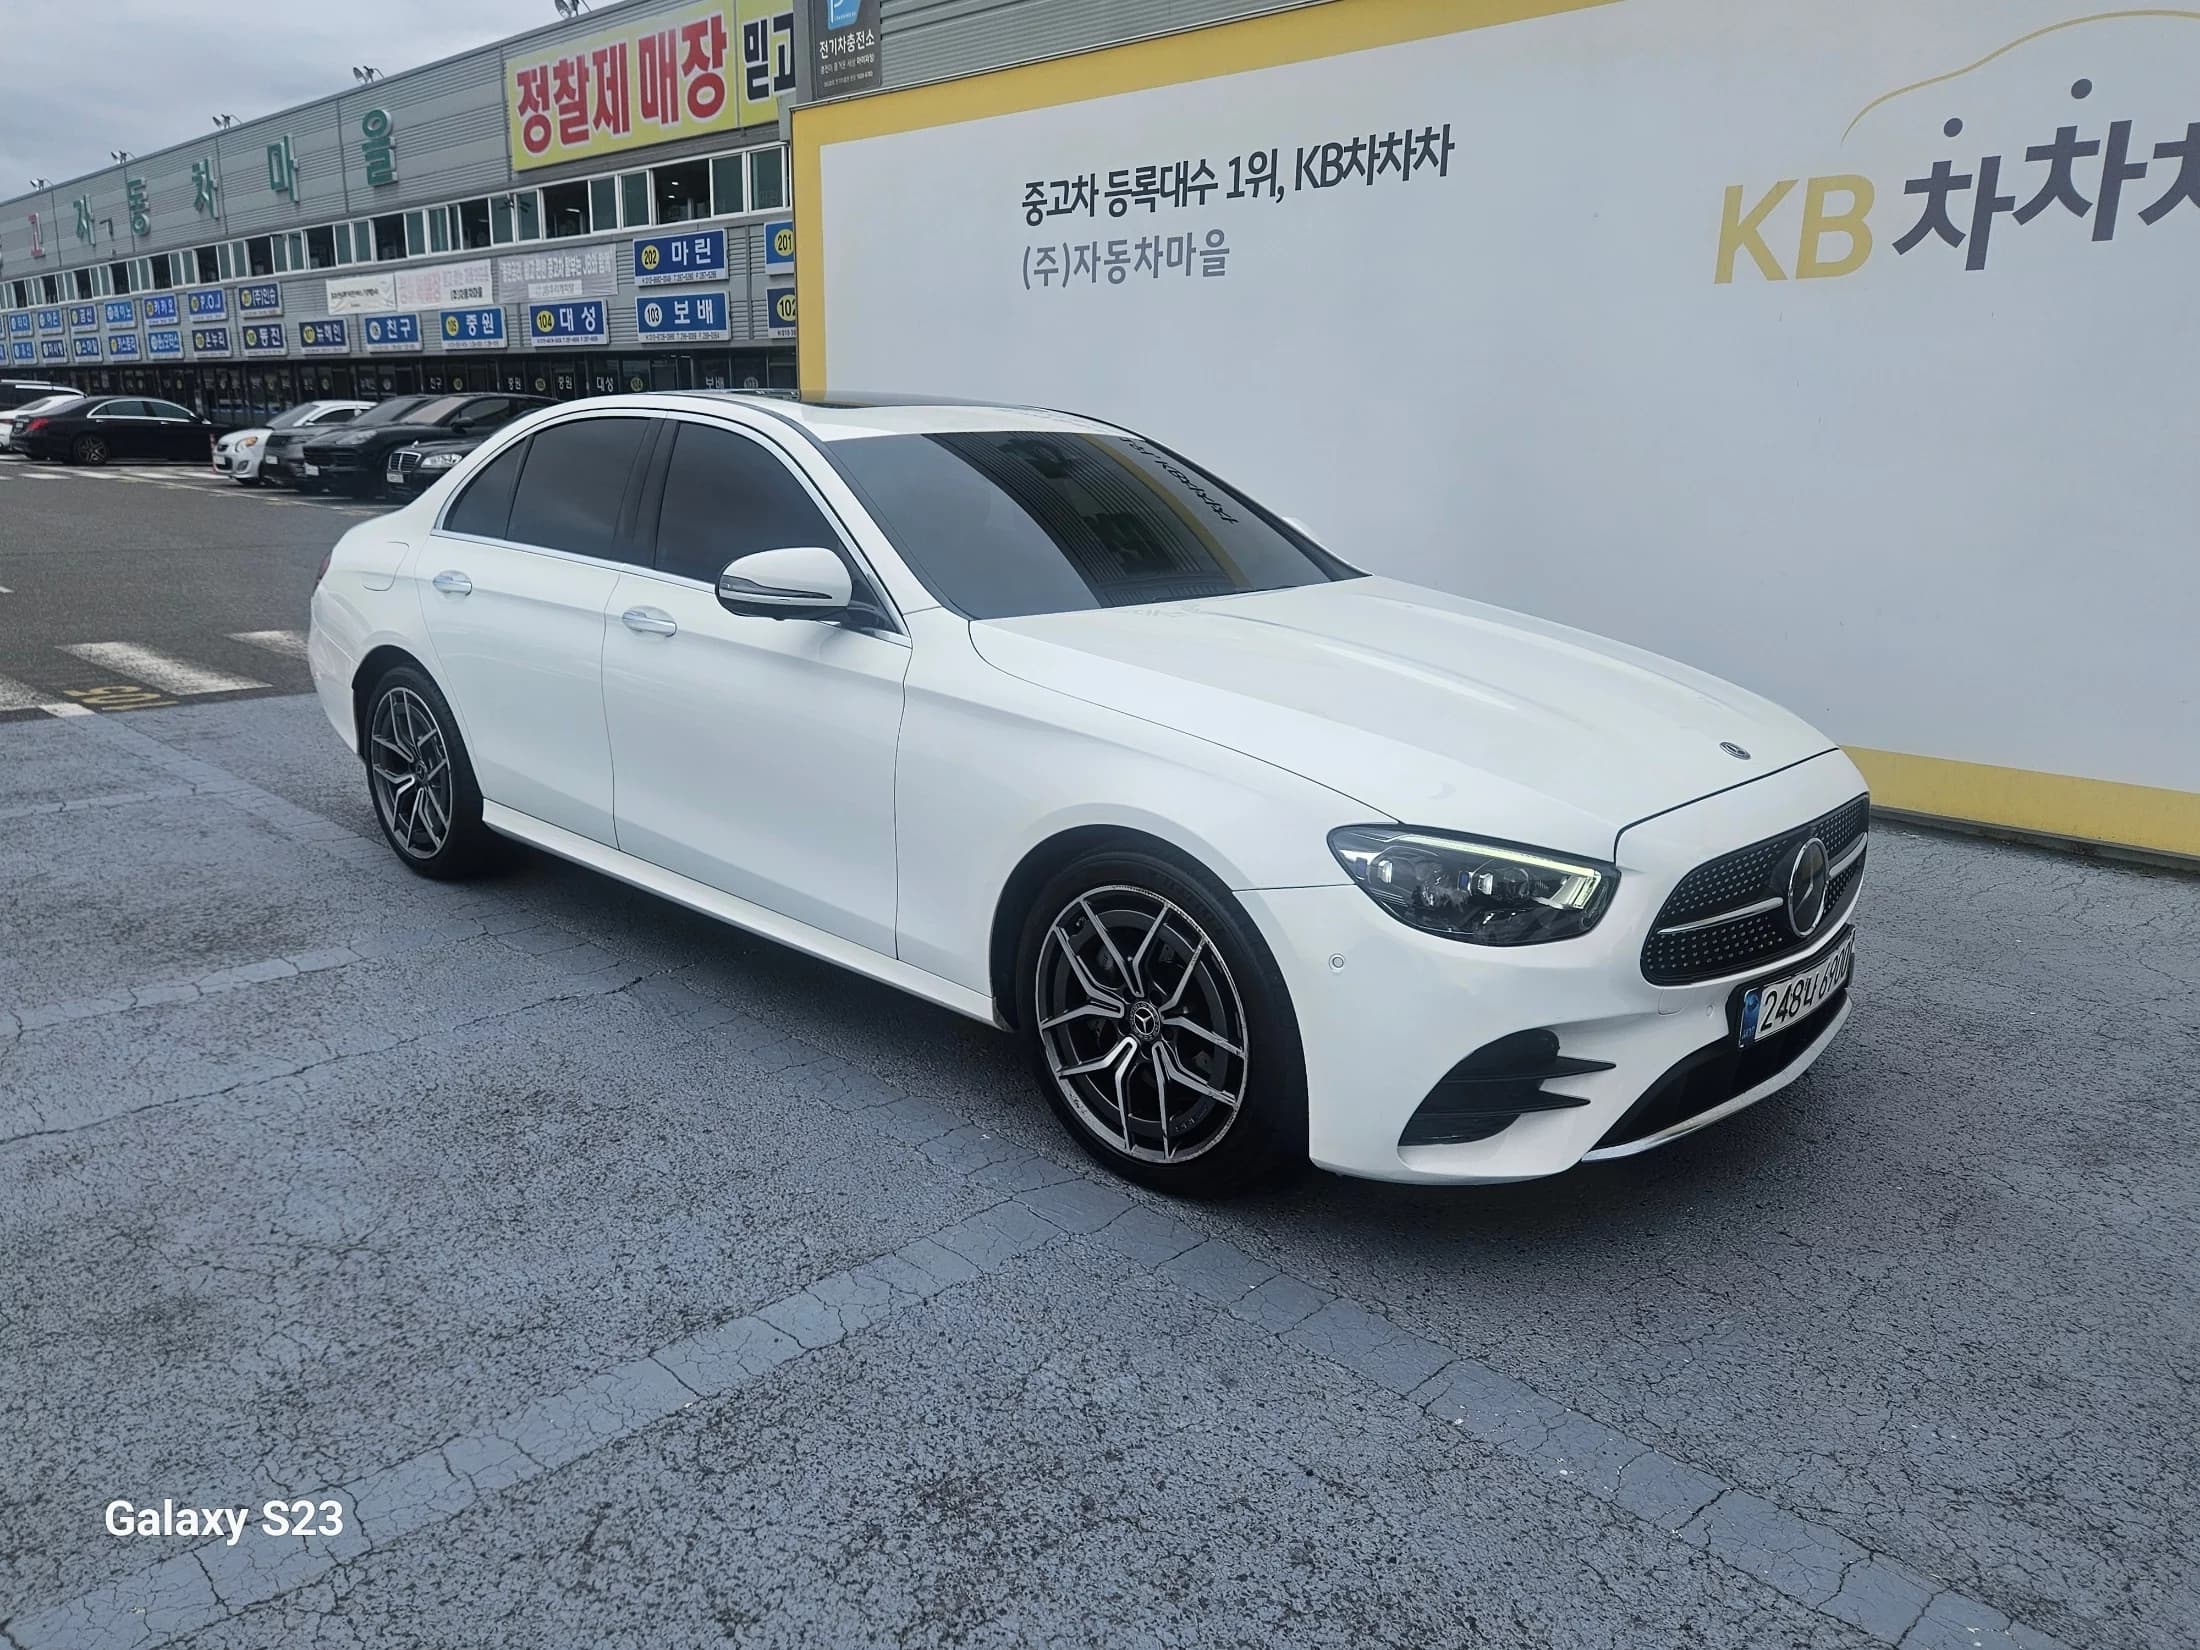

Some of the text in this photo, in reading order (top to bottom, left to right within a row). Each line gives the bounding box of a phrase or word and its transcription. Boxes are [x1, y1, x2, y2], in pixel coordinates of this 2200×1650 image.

[819, 28, 875, 60] 전기차충전소
[517, 12, 796, 154] 정찰제 매장 믿고
[1021, 123, 1455, 226] 중고차 등록대수 1위, KB차차차
[777, 234, 792, 251] 201
[1714, 174, 1875, 284] KB
[644, 238, 711, 266] 202 마린
[1022, 228, 1230, 290] (주)자동차마을
[465, 312, 495, 336] 중원
[538, 305, 596, 332] 104 대성
[647, 299, 714, 325] 103 보배
[259, 328, 281, 346] 동진
[387, 318, 412, 339] 친구
[596, 376, 614, 392] 대성
